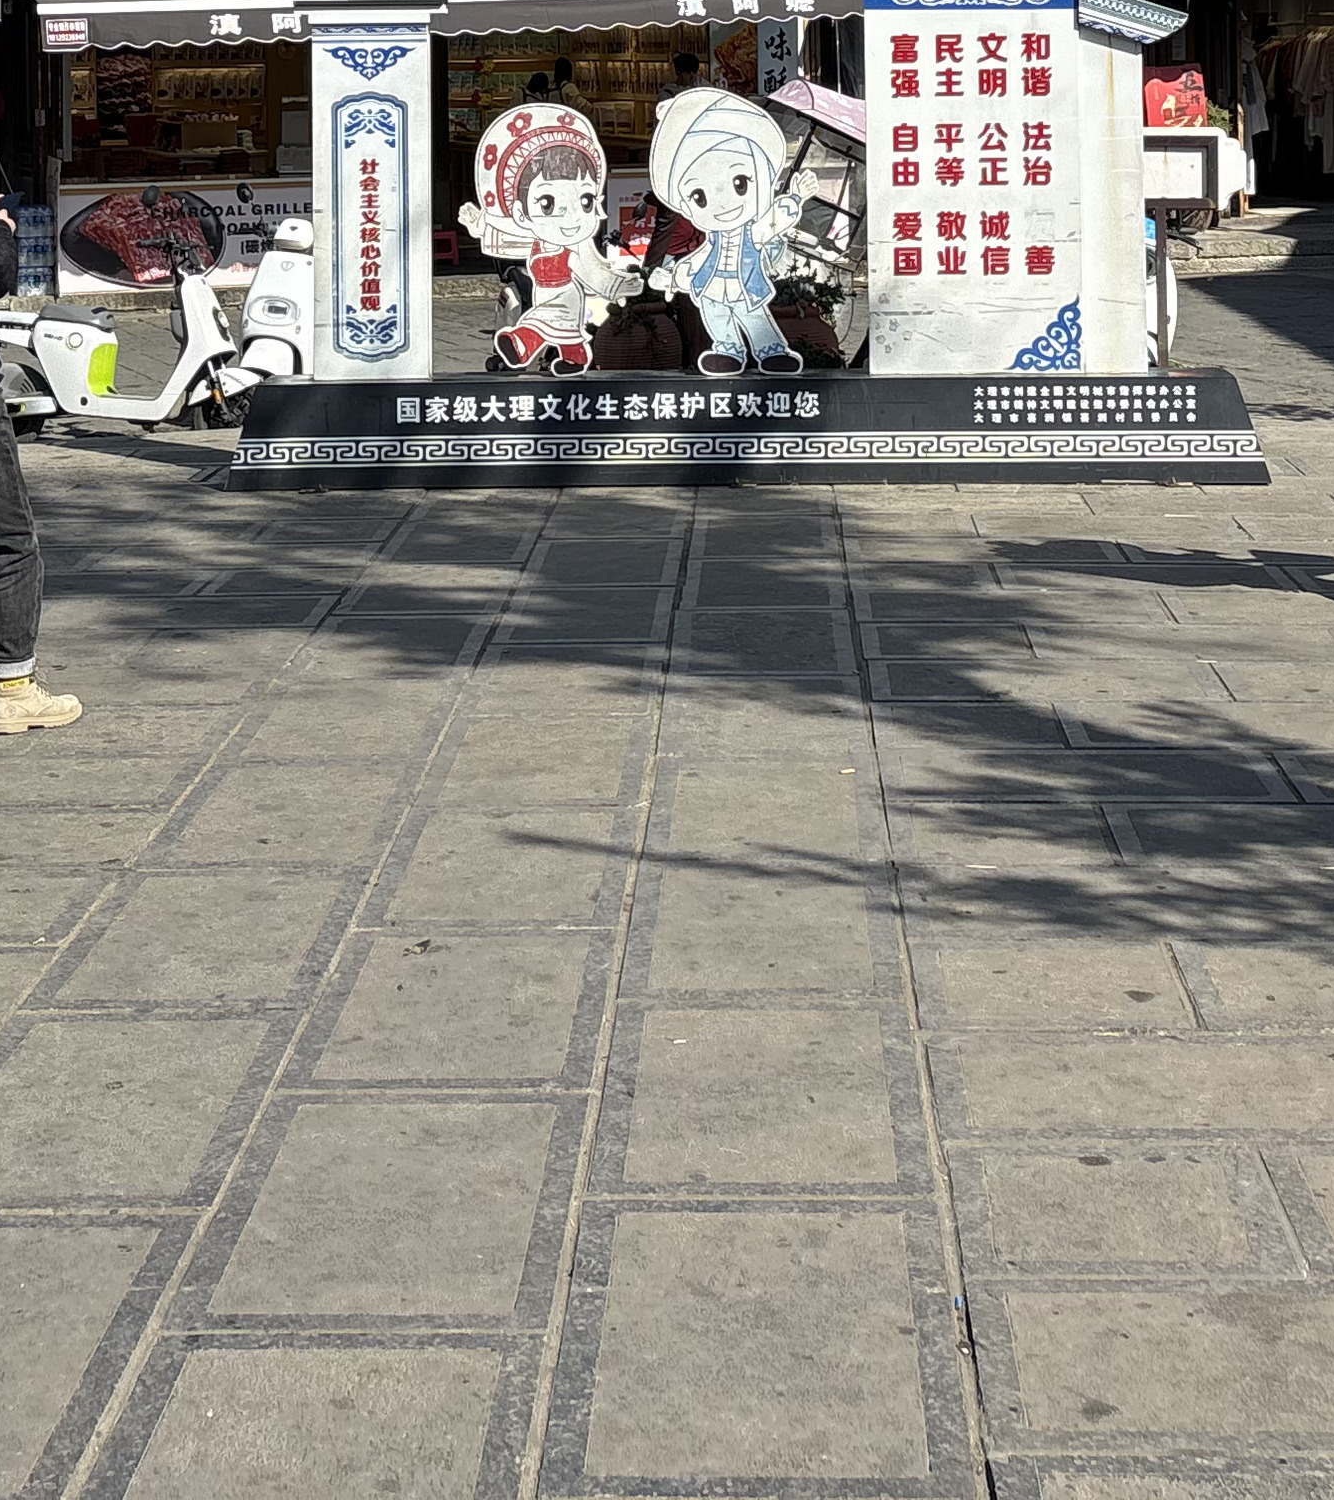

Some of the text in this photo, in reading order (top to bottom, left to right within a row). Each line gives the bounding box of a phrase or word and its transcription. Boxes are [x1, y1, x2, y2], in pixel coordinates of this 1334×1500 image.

[890, 34, 920, 98] 富强
[934, 34, 964, 97] 民主
[976, 33, 1008, 97] 文明
[1020, 33, 1052, 97] 和谐
[892, 123, 920, 187] 自由
[934, 123, 965, 187] 平等
[977, 123, 1009, 186] 公正
[1022, 122, 1053, 186] 法治
[177, 202, 313, 218] RCOAL GRILLE
[359, 158, 382, 312] 社会主义核心价值观
[892, 212, 923, 276] 爱国
[936, 211, 967, 275] 敬业
[979, 211, 1011, 276] 诚信
[396, 391, 821, 425] 国家级大理文化生态保护区欢迎您
